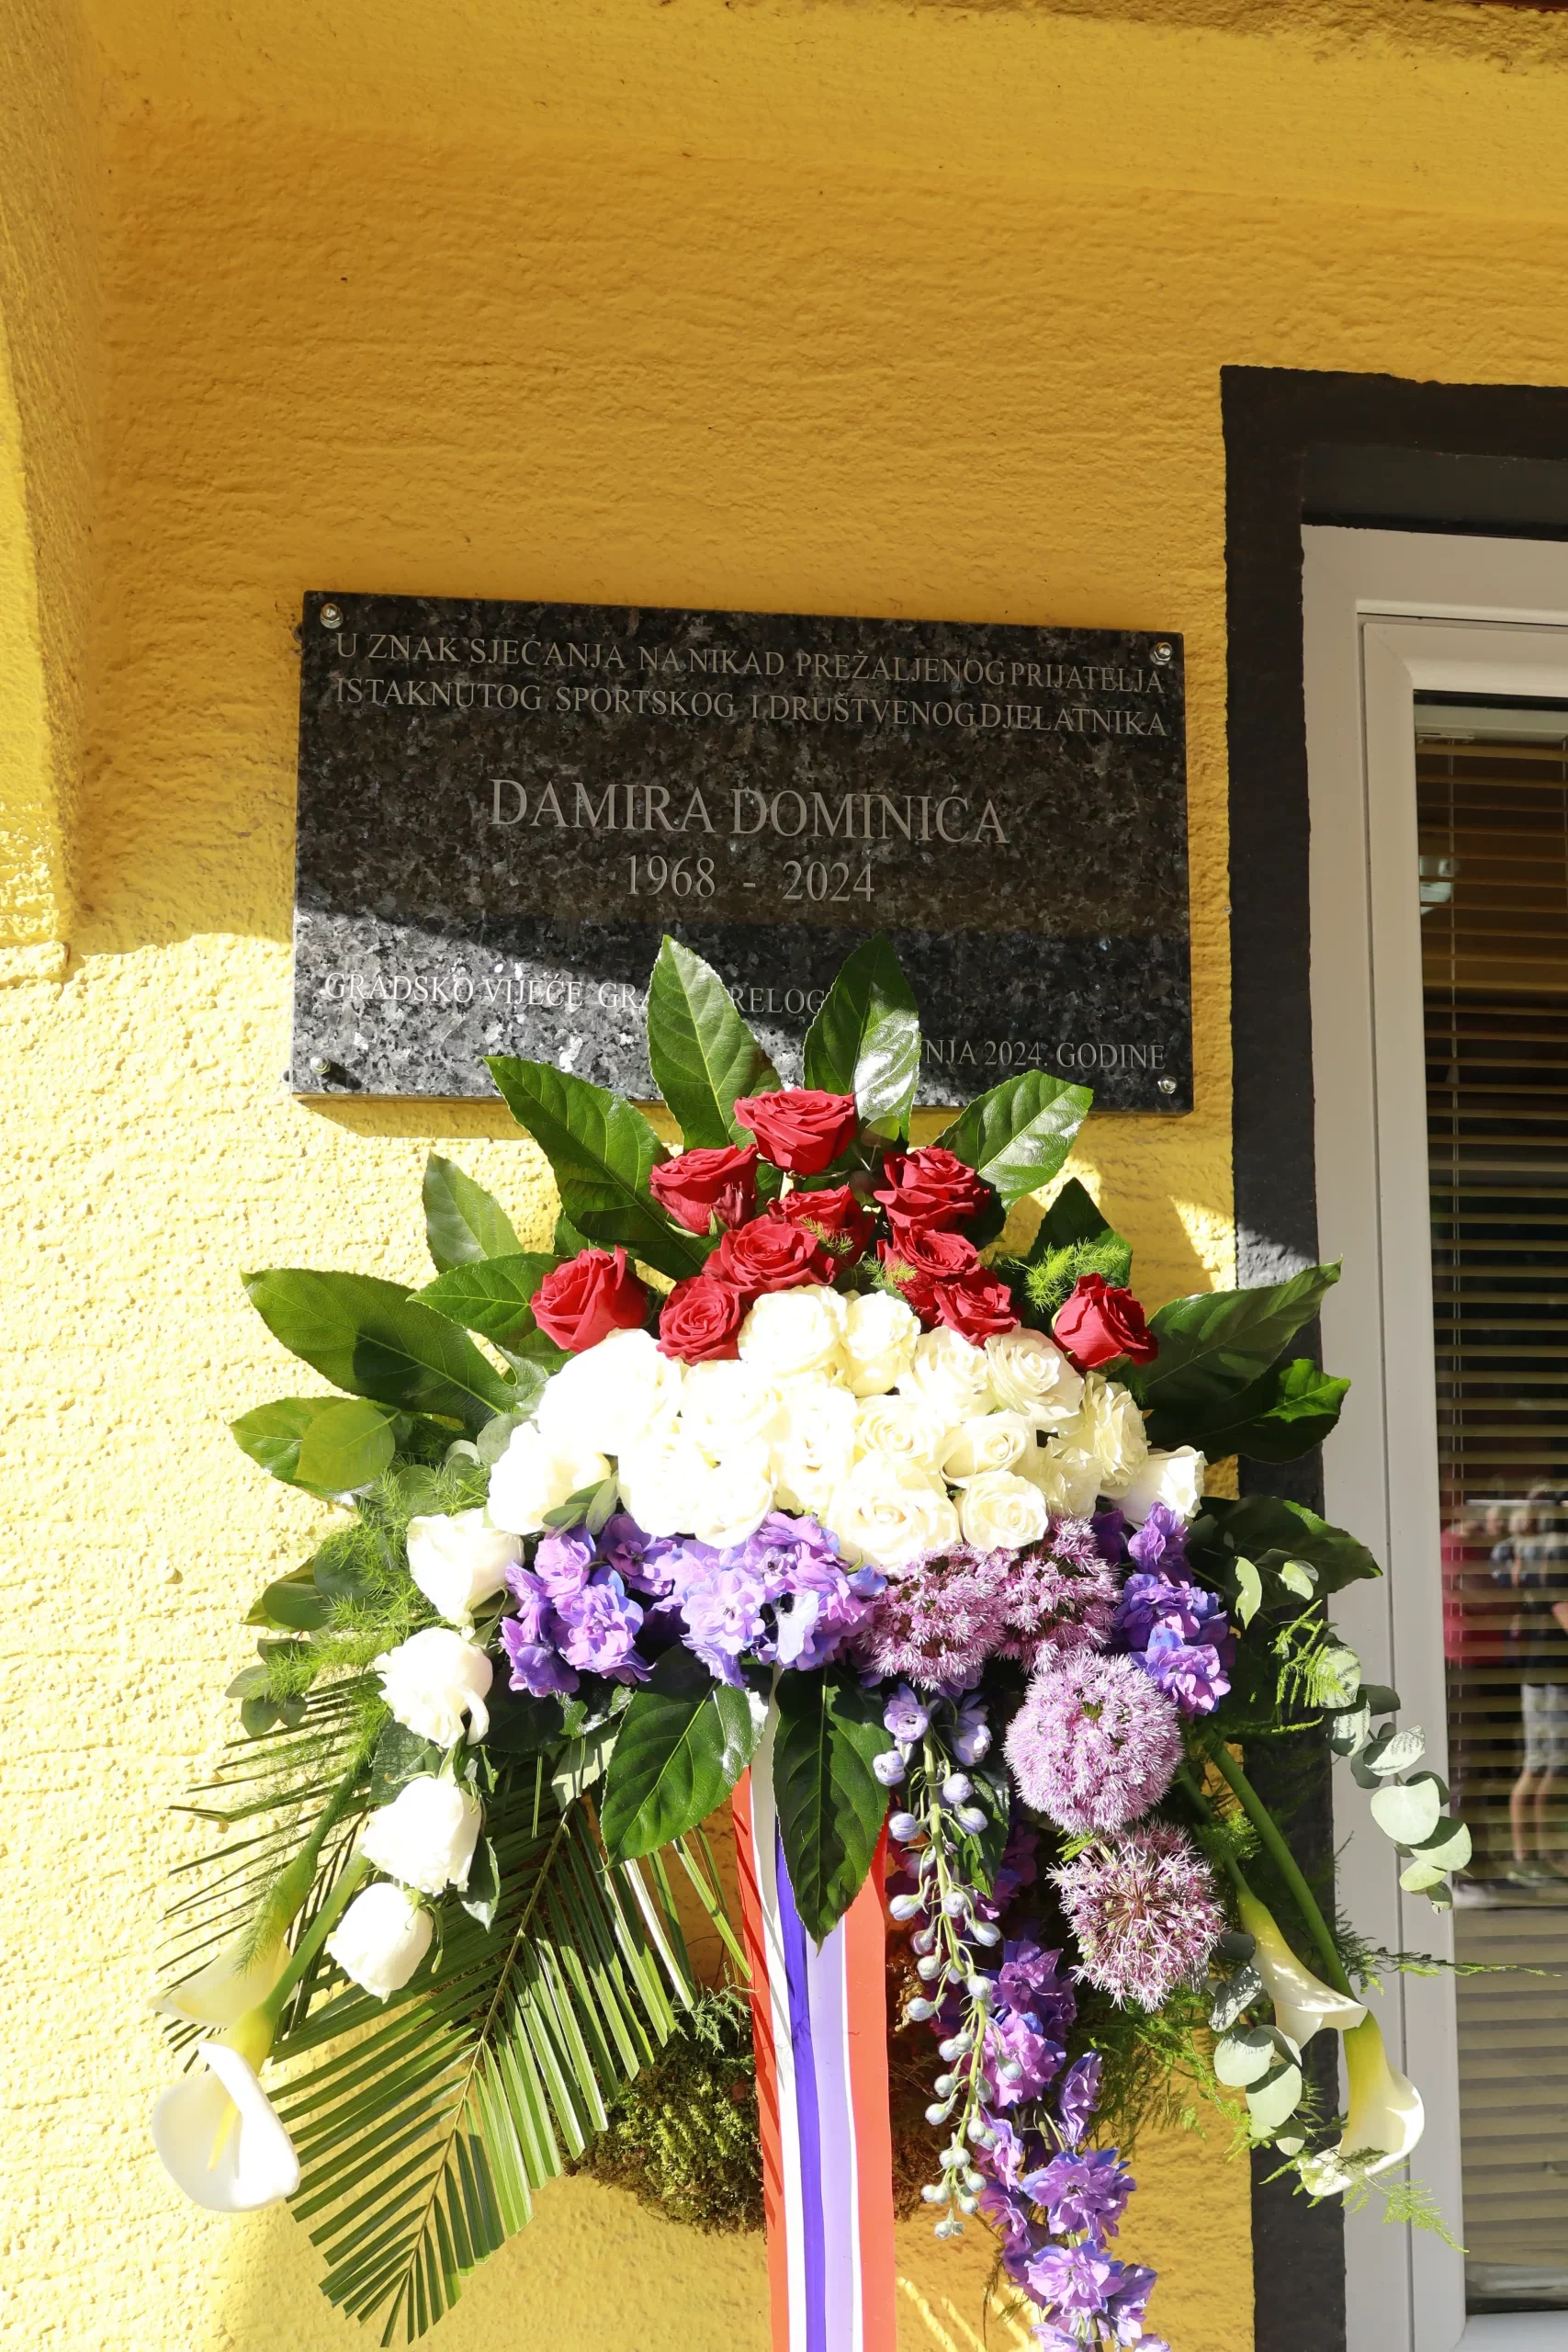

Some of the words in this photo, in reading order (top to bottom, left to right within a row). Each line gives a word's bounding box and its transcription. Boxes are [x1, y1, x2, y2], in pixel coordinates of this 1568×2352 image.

[336, 633, 357, 659] U
[367, 634, 460, 662] ZNAK
[470, 634, 626, 670] SJEĆANJA
[637, 646, 681, 673] NA
[687, 648, 785, 677] NIKAD
[797, 650, 1005, 685] PREŽALJENOG
[1010, 662, 1165, 695] PRIJATELJA
[336, 676, 542, 710] ISTAKNUTOG
[557, 686, 733, 718] SPORTSKOG
[751, 695, 759, 719] I
[770, 692, 974, 728] DRUŠTVENOG
[980, 703, 1168, 737] DJELATNIKA
[489, 778, 716, 833] DAMIRA
[730, 784, 1010, 844] DOMINIĆA
[626, 854, 716, 898] 1968
[783, 859, 875, 903] 2024
[324, 972, 473, 1003] GRADSKO
[484, 974, 583, 1007] VIJEĆE
[985, 1040, 1047, 1067] 2024.
[1057, 1042, 1167, 1069] GODINE
